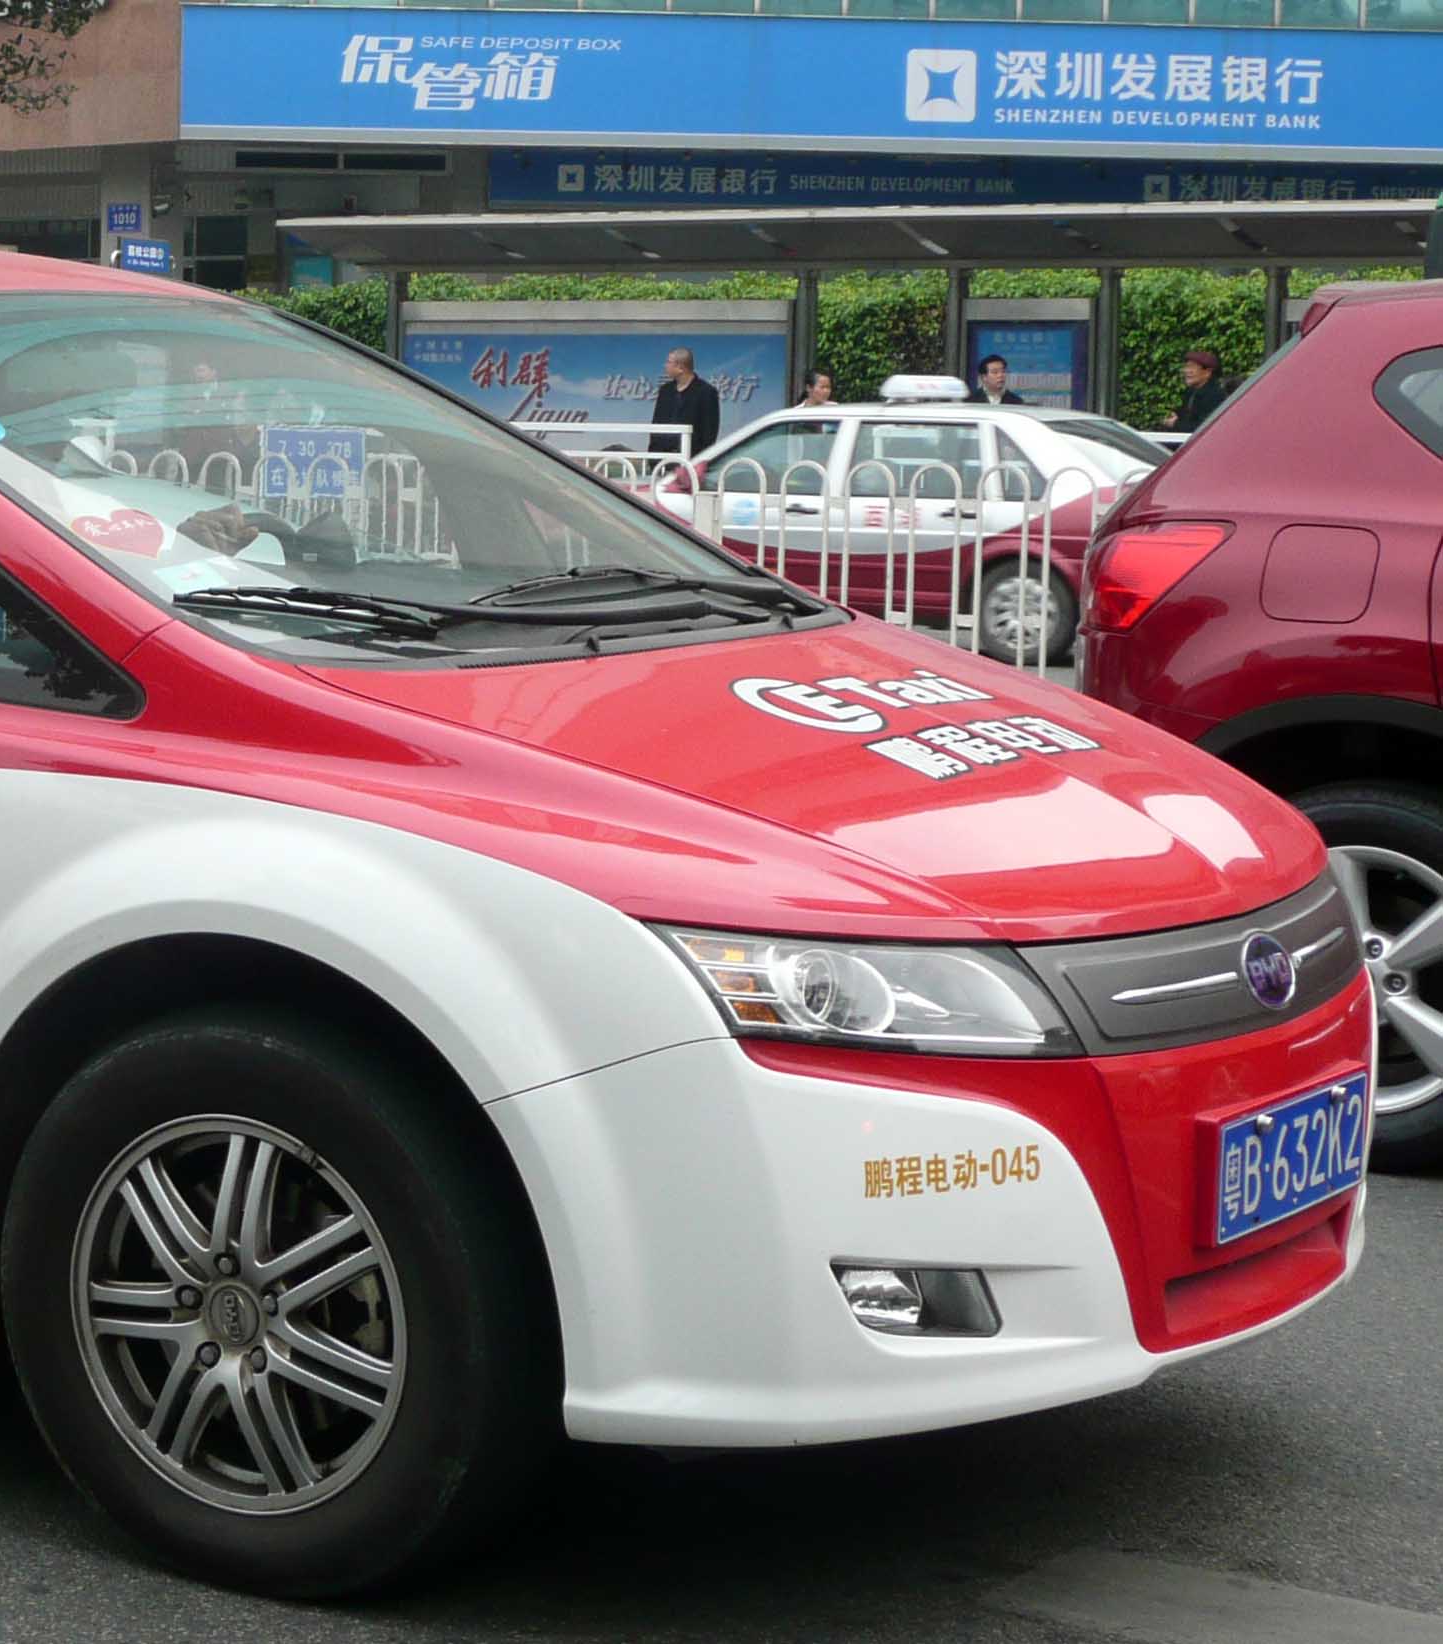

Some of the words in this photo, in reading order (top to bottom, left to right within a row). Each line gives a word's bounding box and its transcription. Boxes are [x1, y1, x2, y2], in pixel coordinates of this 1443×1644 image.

[420, 36, 474, 49] SAFE
[479, 37, 570, 50] DEPOSIT
[576, 38, 622, 51] BOX
[340, 34, 560, 111] 保管箱
[994, 51, 1324, 104] 深圳发展银行
[994, 108, 1102, 124] SHENZHEN
[1112, 111, 1256, 127] DEVELOPMENT
[1265, 114, 1321, 129] BANK
[593, 164, 778, 195] 深圳发展银行
[789, 175, 865, 191] SHENZHEN
[870, 177, 972, 193] DEVELOPMENT
[974, 179, 1015, 194] BANK
[1179, 175, 1356, 201] 深圳发展银行
[816, 669, 997, 709] Taxi
[864, 1144, 1040, 1199] 鹏程电动-045
